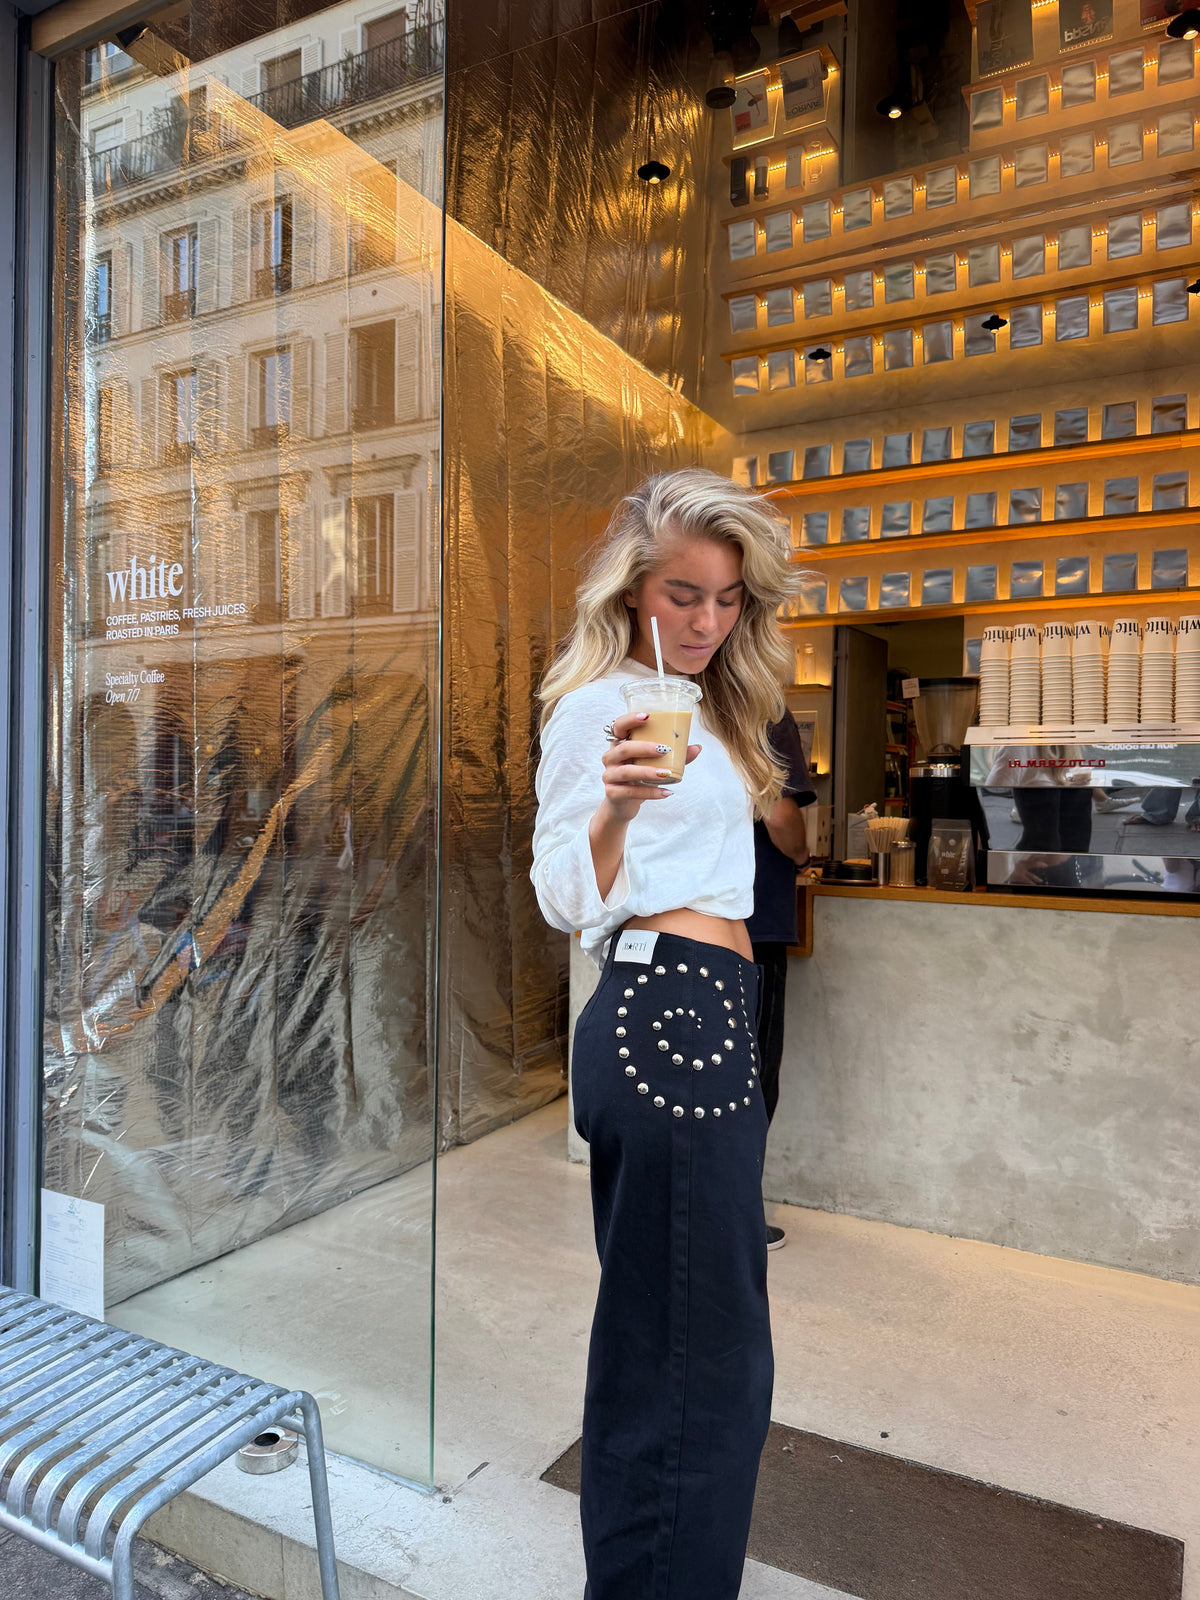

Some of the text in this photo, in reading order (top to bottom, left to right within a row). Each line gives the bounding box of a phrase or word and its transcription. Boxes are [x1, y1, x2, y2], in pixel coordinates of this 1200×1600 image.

[106, 555, 183, 603] white
[106, 603, 246, 626] COFFEE, PASTRIES, FRESH JUICES
[106, 624, 179, 640] ROASTED IN PARIS
[1116, 622, 1139, 636] hite
[105, 669, 165, 688] Specialty Coffee
[105, 688, 141, 706] Open 7/7
[1027, 759, 1105, 768] MARZOCCO
